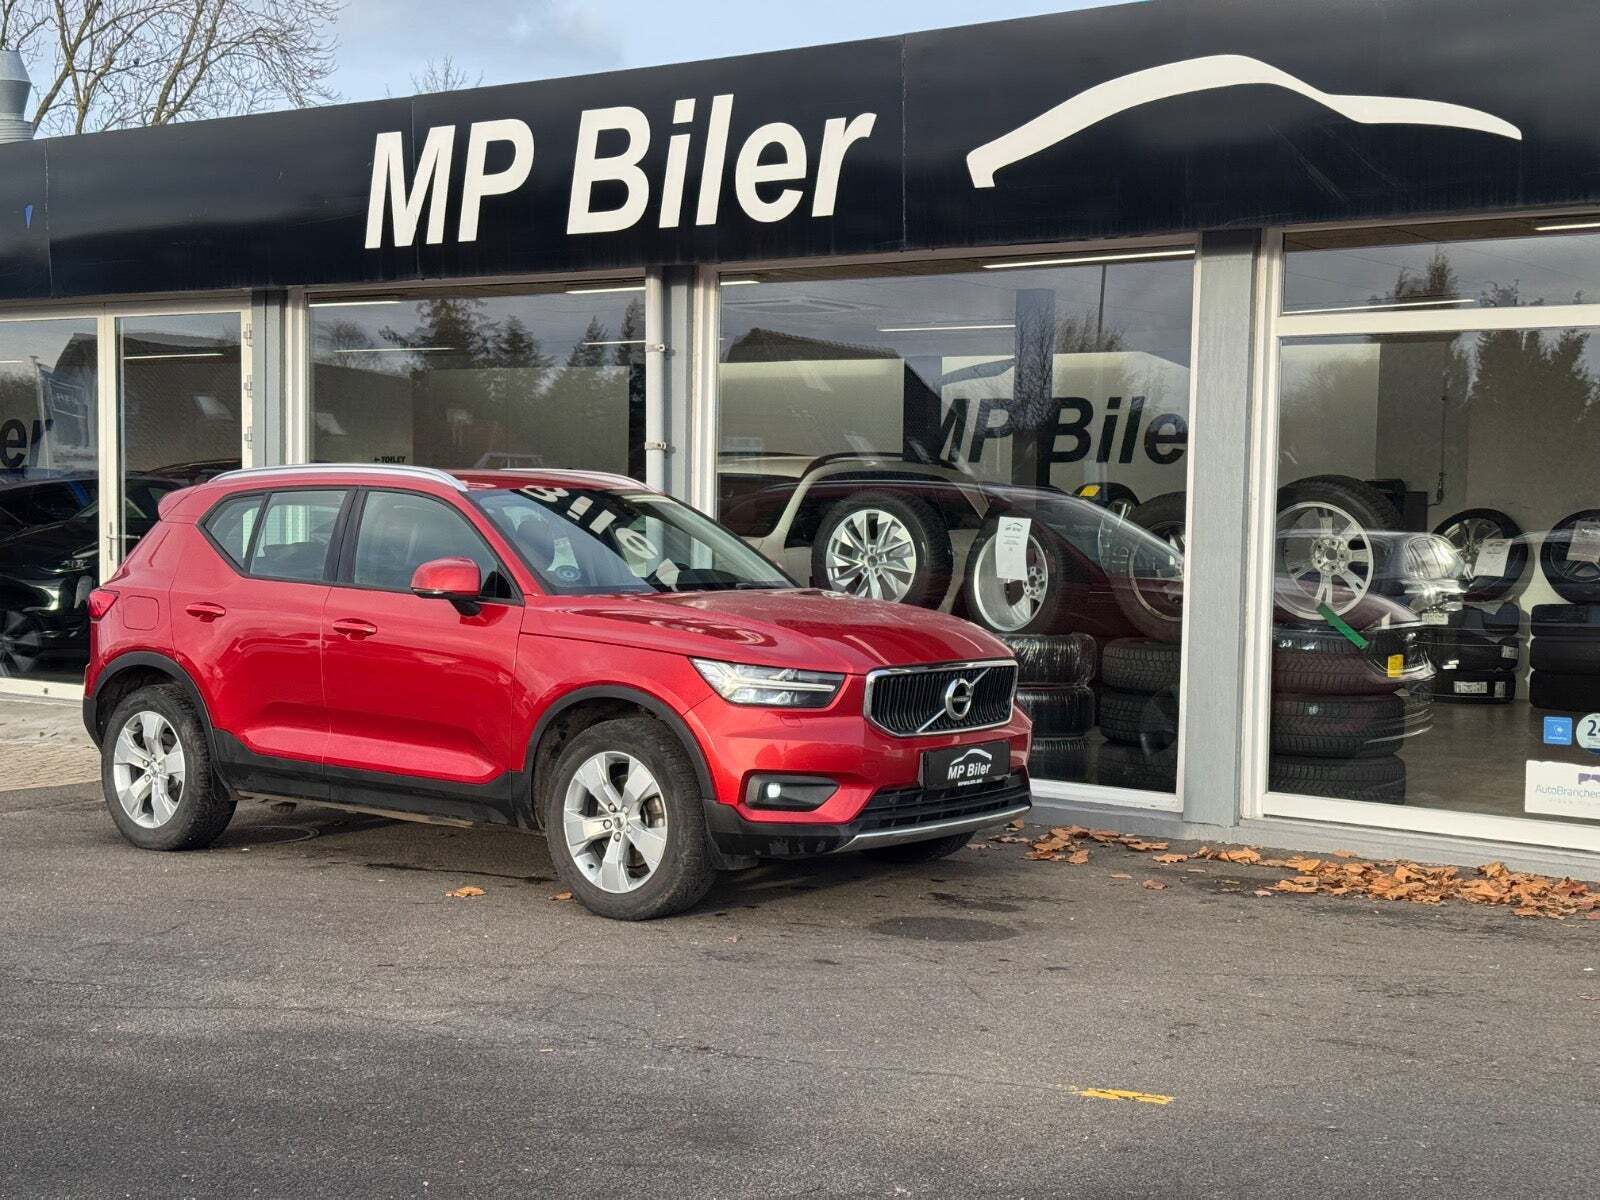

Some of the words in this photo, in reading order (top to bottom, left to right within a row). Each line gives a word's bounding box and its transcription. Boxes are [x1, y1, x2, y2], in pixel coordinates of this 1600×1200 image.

[365, 118, 534, 249] MP
[566, 93, 877, 235] Biler
[947, 764, 965, 780] MP
[967, 762, 991, 777] Biler
